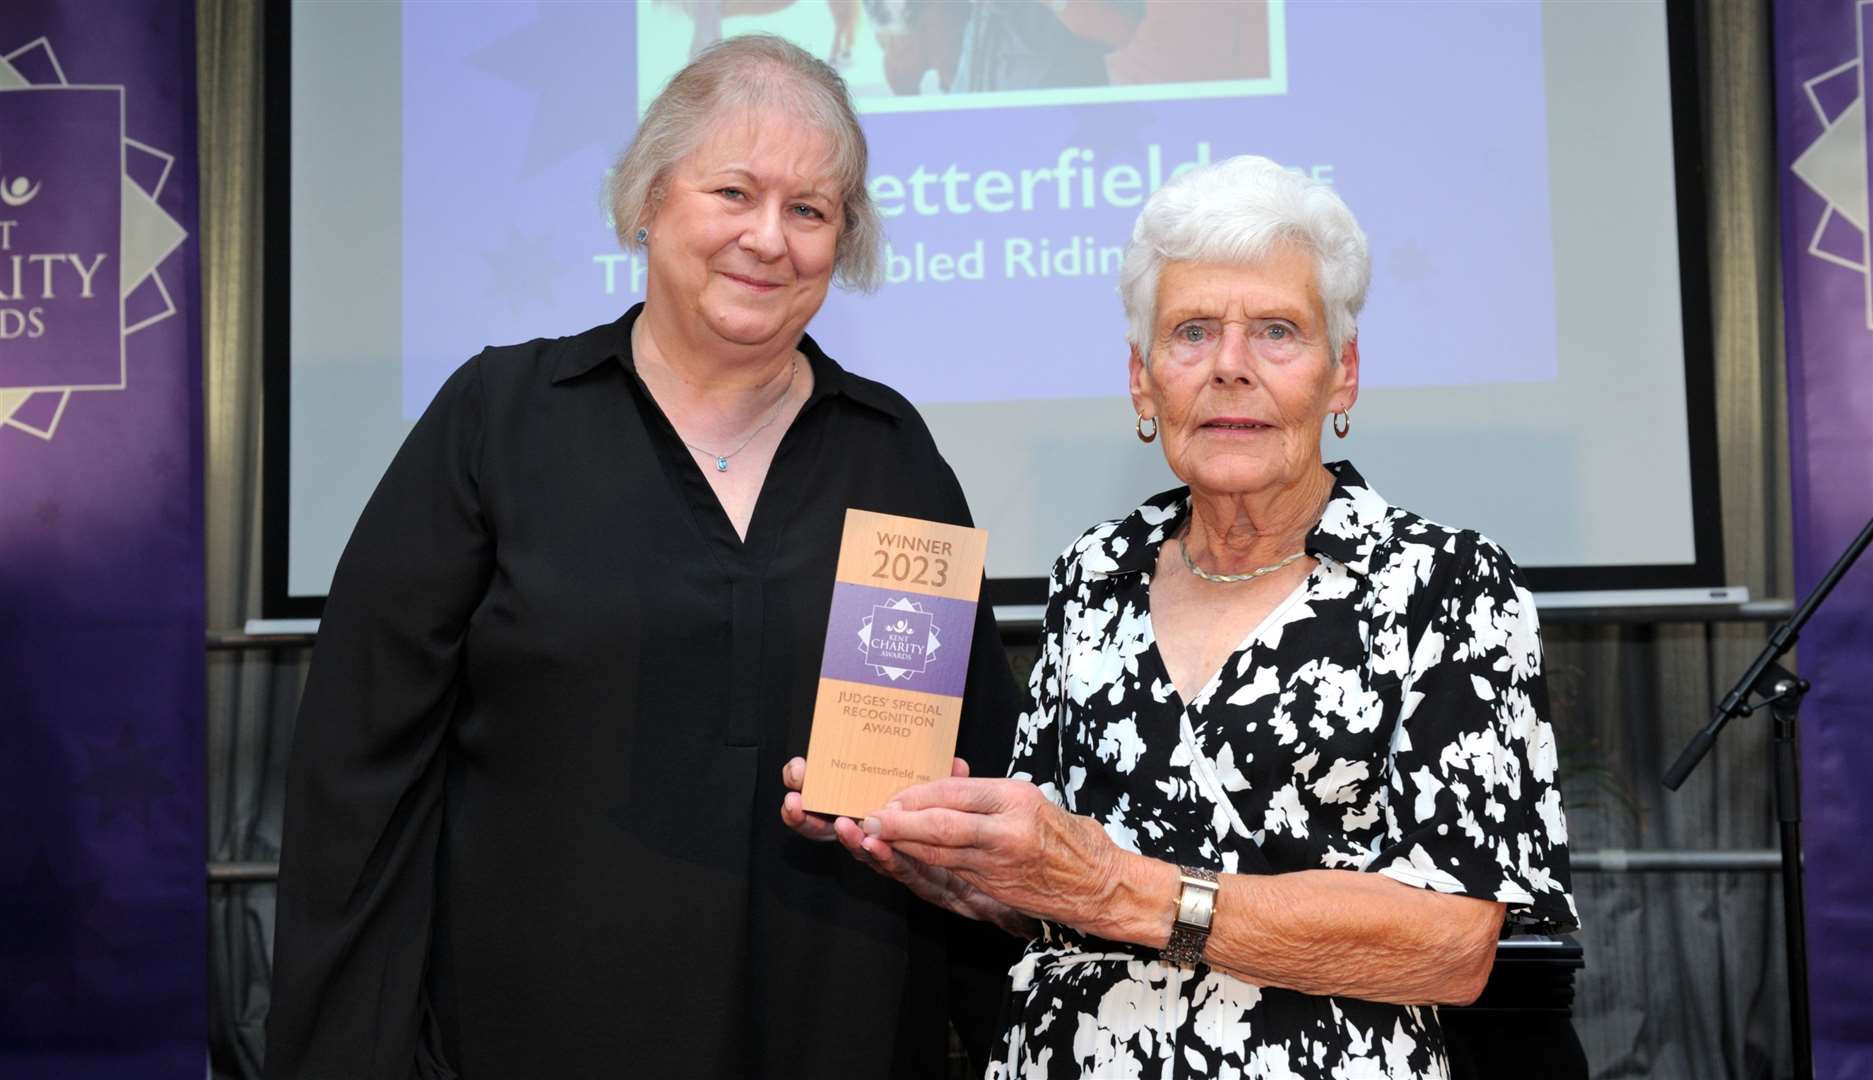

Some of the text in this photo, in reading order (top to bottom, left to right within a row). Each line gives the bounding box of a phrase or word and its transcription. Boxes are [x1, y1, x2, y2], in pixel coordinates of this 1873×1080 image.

[867, 142, 1211, 218] etterfiel
[0, 252, 107, 300] ITY
[592, 235, 1124, 294] Th bled Ridin
[0, 306, 46, 339] DS
[876, 530, 952, 556] WINNER
[871, 549, 949, 588] 2023
[871, 638, 925, 655] CHARITY
[889, 634, 909, 643] KENT
[880, 650, 912, 661] AWARDS
[842, 705, 936, 729] RECOGNITION
[893, 699, 943, 716] SPECIAL
[862, 722, 912, 738] AWARD
[831, 758, 858, 772] Nora
[860, 762, 914, 780] Setterfield
